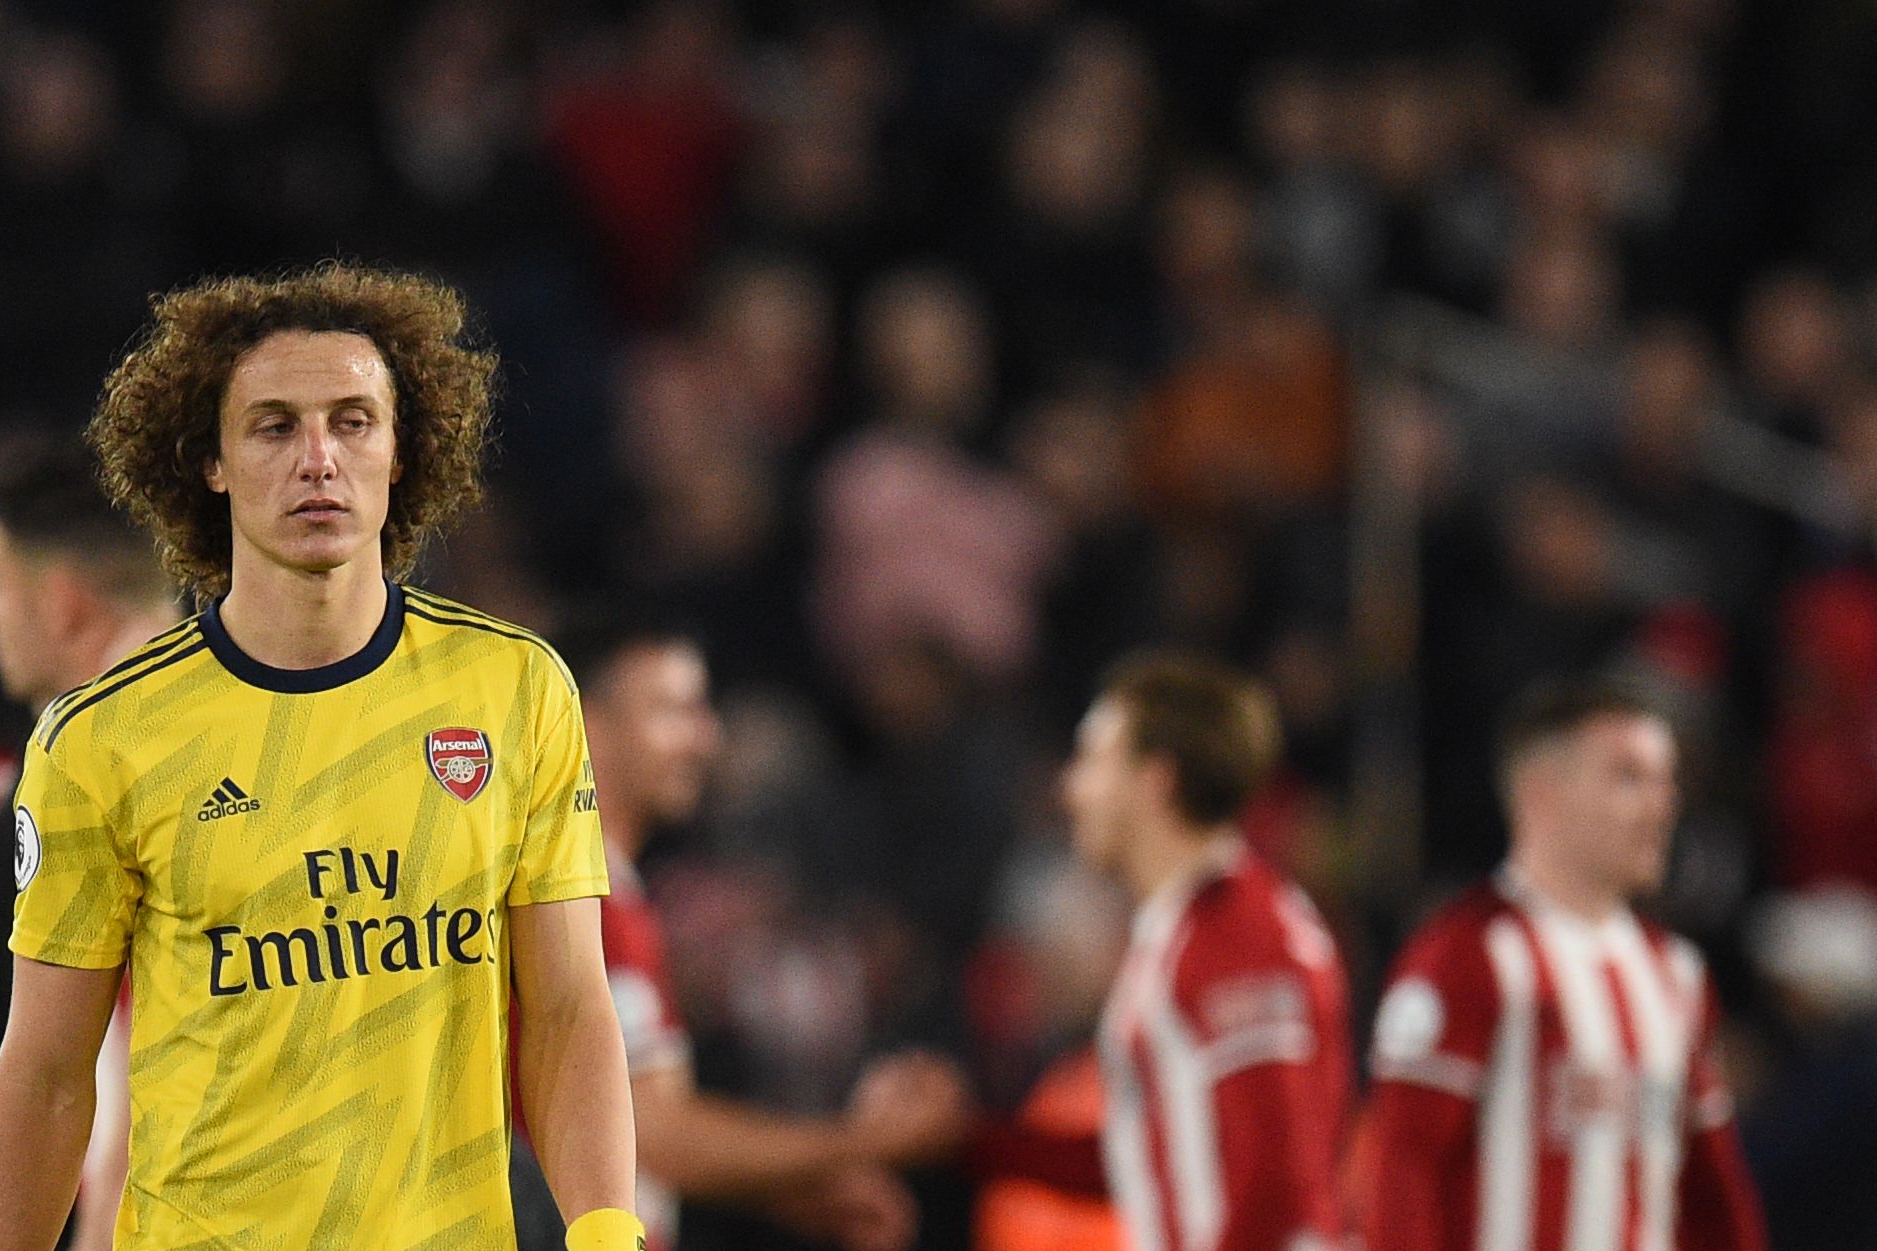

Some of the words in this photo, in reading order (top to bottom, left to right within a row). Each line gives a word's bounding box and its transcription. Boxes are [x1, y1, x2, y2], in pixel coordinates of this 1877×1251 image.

[433, 738, 483, 752] Arsenal
[197, 799, 261, 822] adidas
[303, 847, 399, 900] Fly
[202, 901, 495, 996] Emirates
